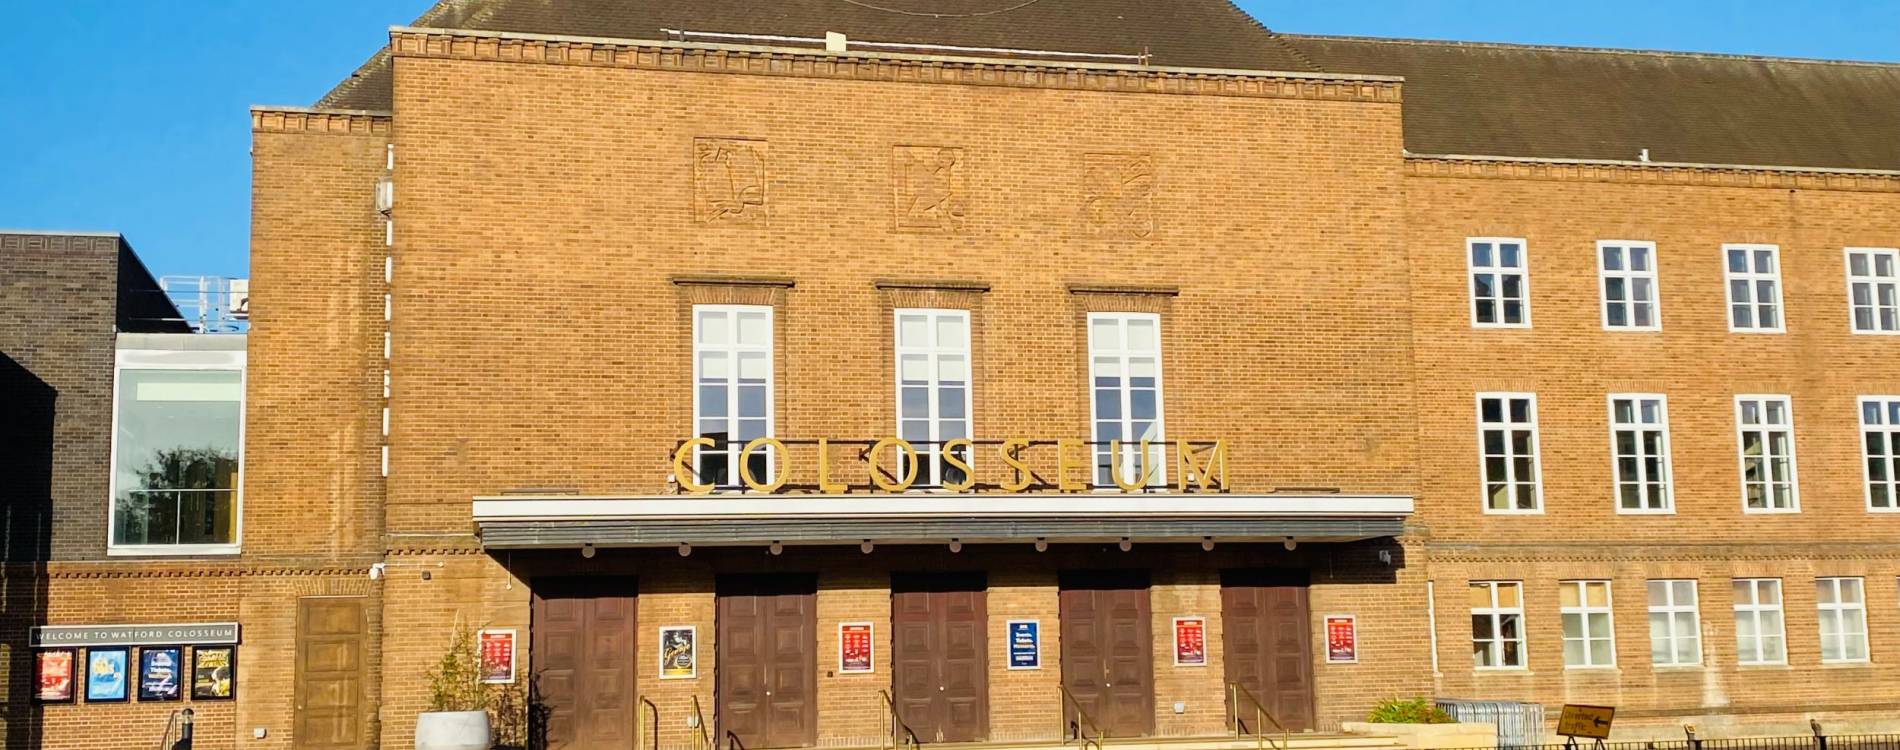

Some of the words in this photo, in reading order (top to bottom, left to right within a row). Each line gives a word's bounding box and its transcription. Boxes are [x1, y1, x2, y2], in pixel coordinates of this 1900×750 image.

[673, 437, 1229, 493] COLOSSEUM
[34, 632, 89, 641] WELCOME
[94, 631, 108, 640] TO
[110, 630, 163, 640] WATFORD
[167, 629, 233, 639] COLOSSEUM
